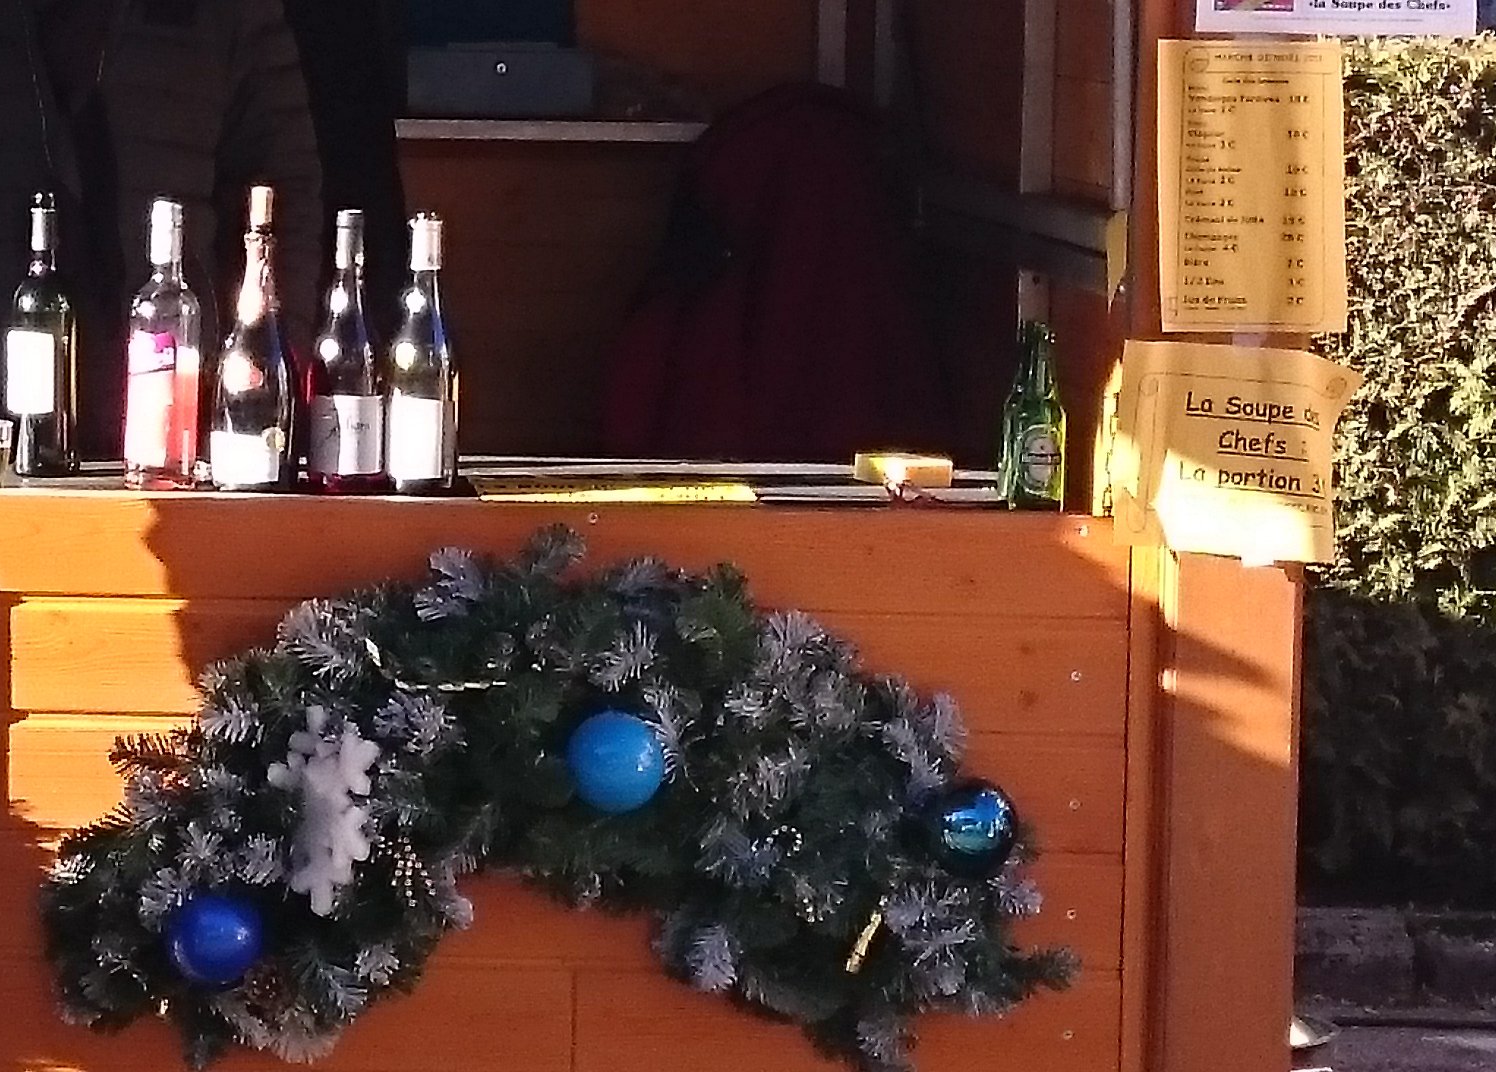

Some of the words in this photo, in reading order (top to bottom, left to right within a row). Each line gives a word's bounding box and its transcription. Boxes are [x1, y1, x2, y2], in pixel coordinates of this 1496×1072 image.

[1186, 391, 1213, 413] La
[1225, 396, 1295, 425] Soupe
[1219, 429, 1287, 454] Chefs
[1180, 460, 1205, 481] La
[1218, 469, 1301, 491] portion
